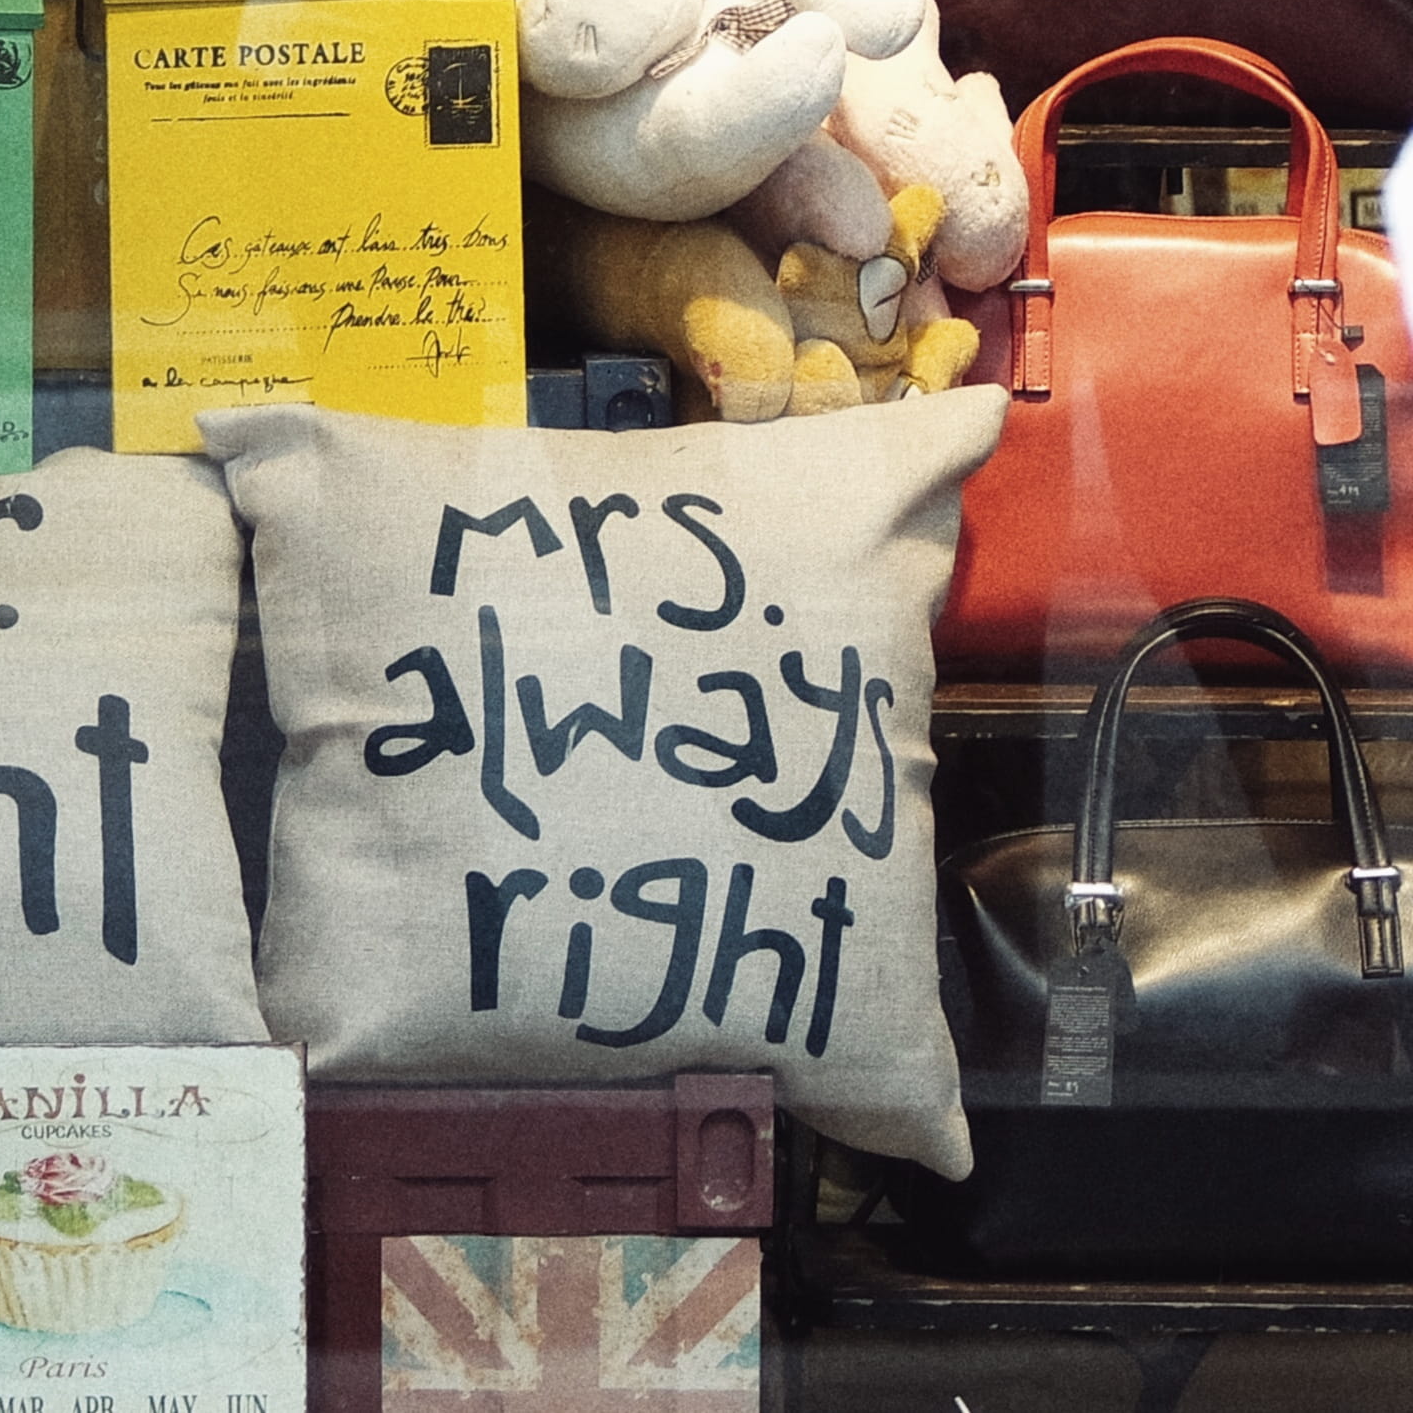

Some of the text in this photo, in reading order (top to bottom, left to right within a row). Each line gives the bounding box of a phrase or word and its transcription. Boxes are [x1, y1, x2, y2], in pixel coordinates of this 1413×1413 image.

[134, 42, 365, 70] CARTE POSTALE
[363, 604, 895, 860] always
[465, 857, 854, 1058] right
[21, 1124, 112, 1141] CUPCAKES
[19, 1354, 109, 1380] Paris
